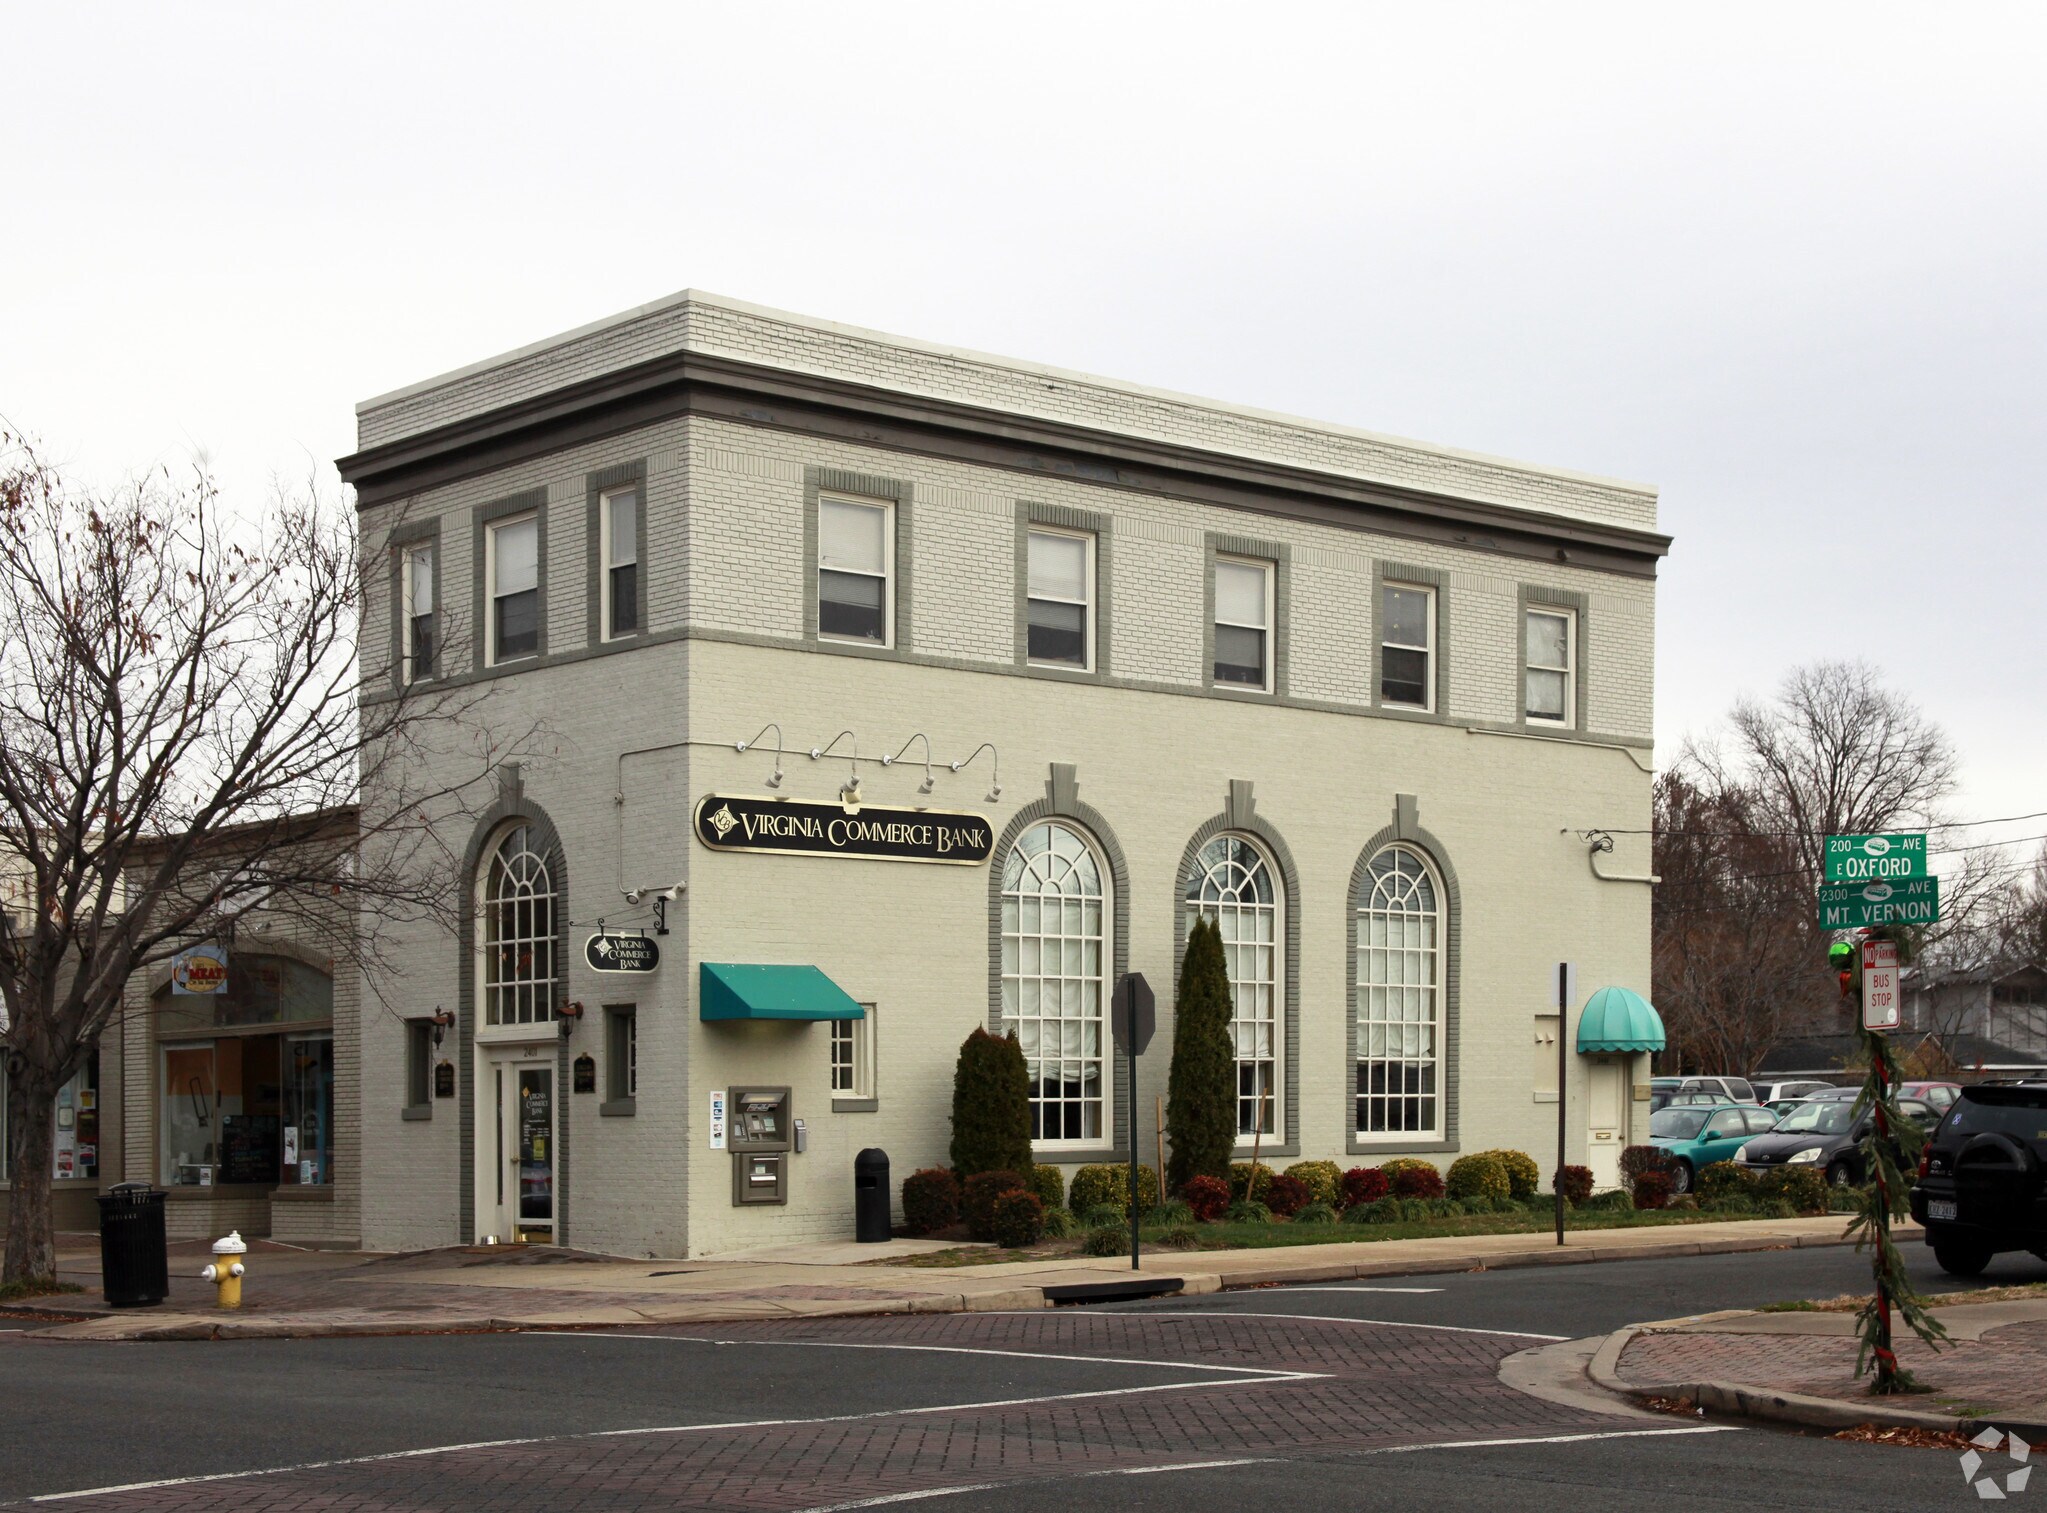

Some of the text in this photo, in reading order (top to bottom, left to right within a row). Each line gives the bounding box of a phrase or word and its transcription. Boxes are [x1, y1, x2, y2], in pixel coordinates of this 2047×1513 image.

[740, 813, 985, 852] VIRGINIA COMMERCE BANK
[1830, 838, 1921, 852] 200 AVE
[1837, 857, 1912, 877] E OXFORD
[1821, 881, 1931, 902] 2300 AVE
[1827, 901, 1931, 924] MT. VERNON
[614, 940, 646, 950] VIRGINIA
[608, 949, 651, 960] COMMERCE
[1864, 947, 1897, 963] NO PARKING
[620, 960, 640, 969] BANK
[1873, 974, 1889, 988] BUS
[1872, 992, 1892, 1007] STOP
